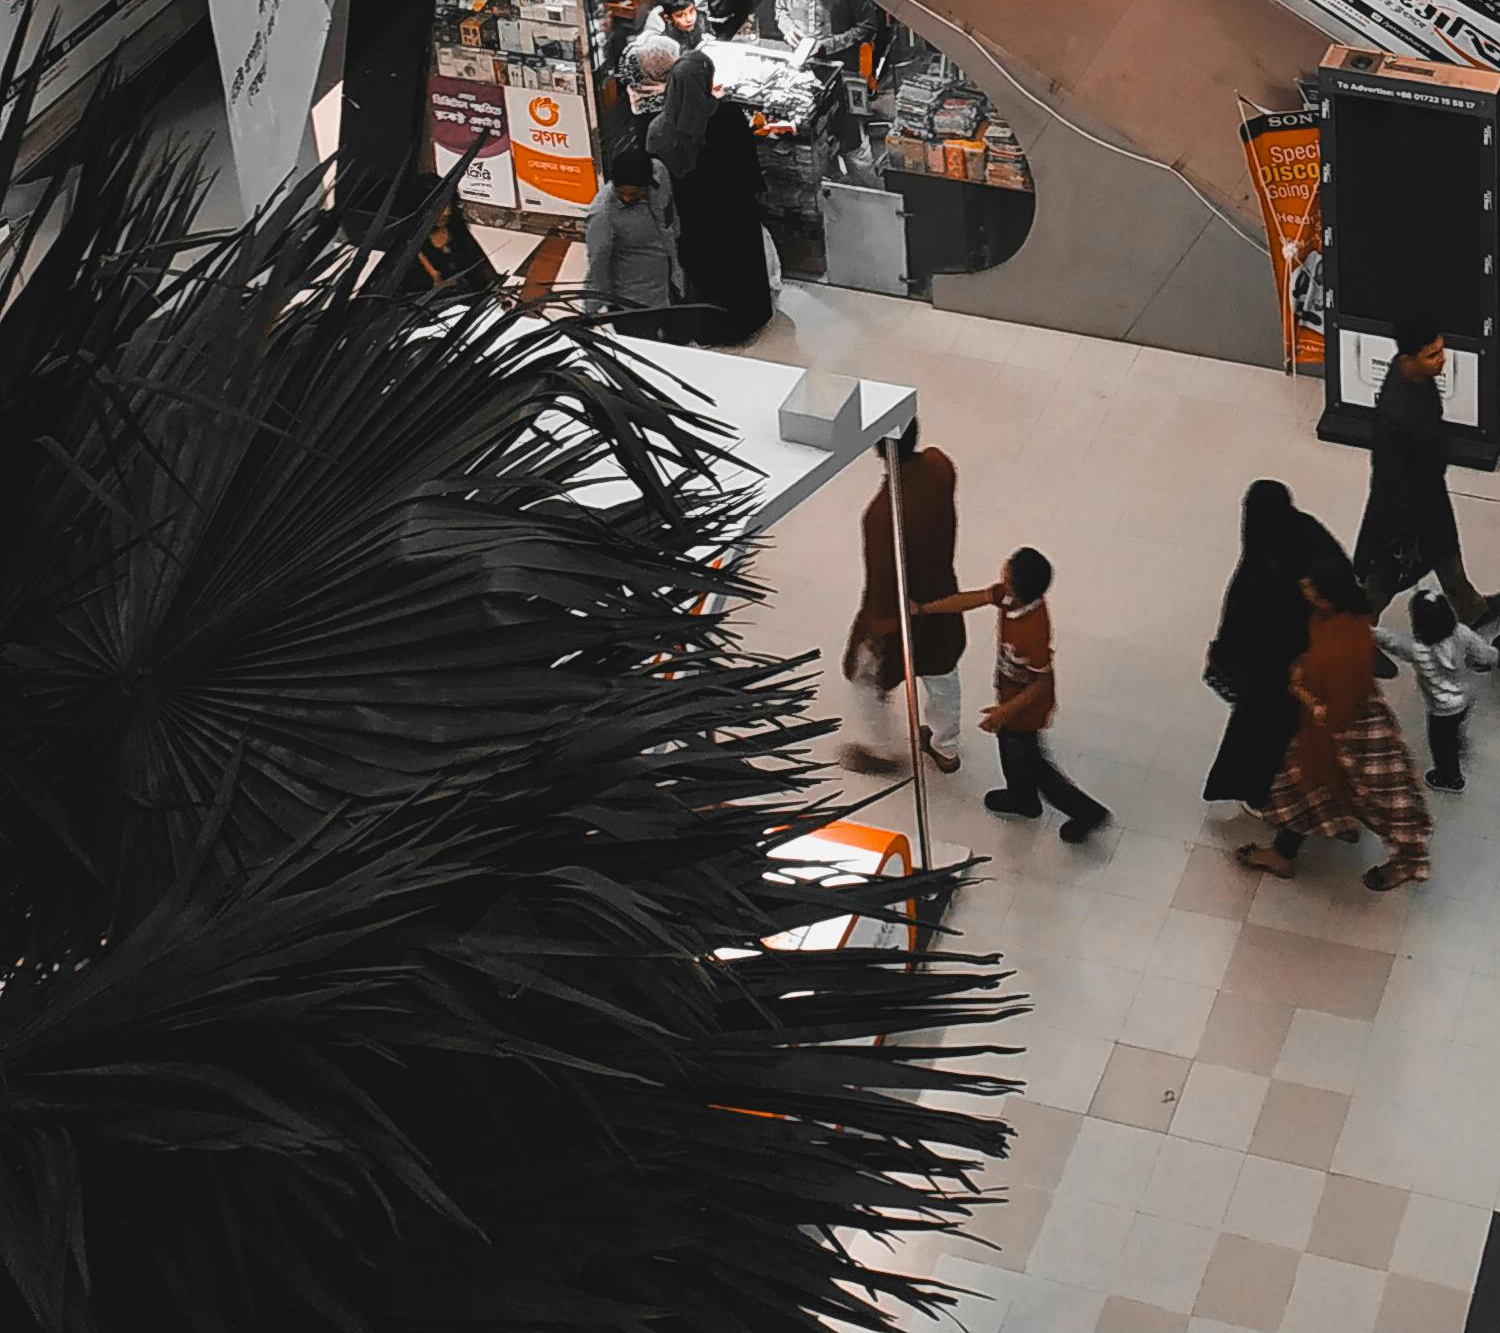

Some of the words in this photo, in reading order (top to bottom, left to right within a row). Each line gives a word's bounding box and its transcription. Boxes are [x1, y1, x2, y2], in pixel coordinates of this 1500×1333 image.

[1337, 81, 1349, 90] To
[1351, 83, 1394, 97] Advertise:
[530, 129, 569, 148] নগদ
[1268, 184, 1310, 201] Going
